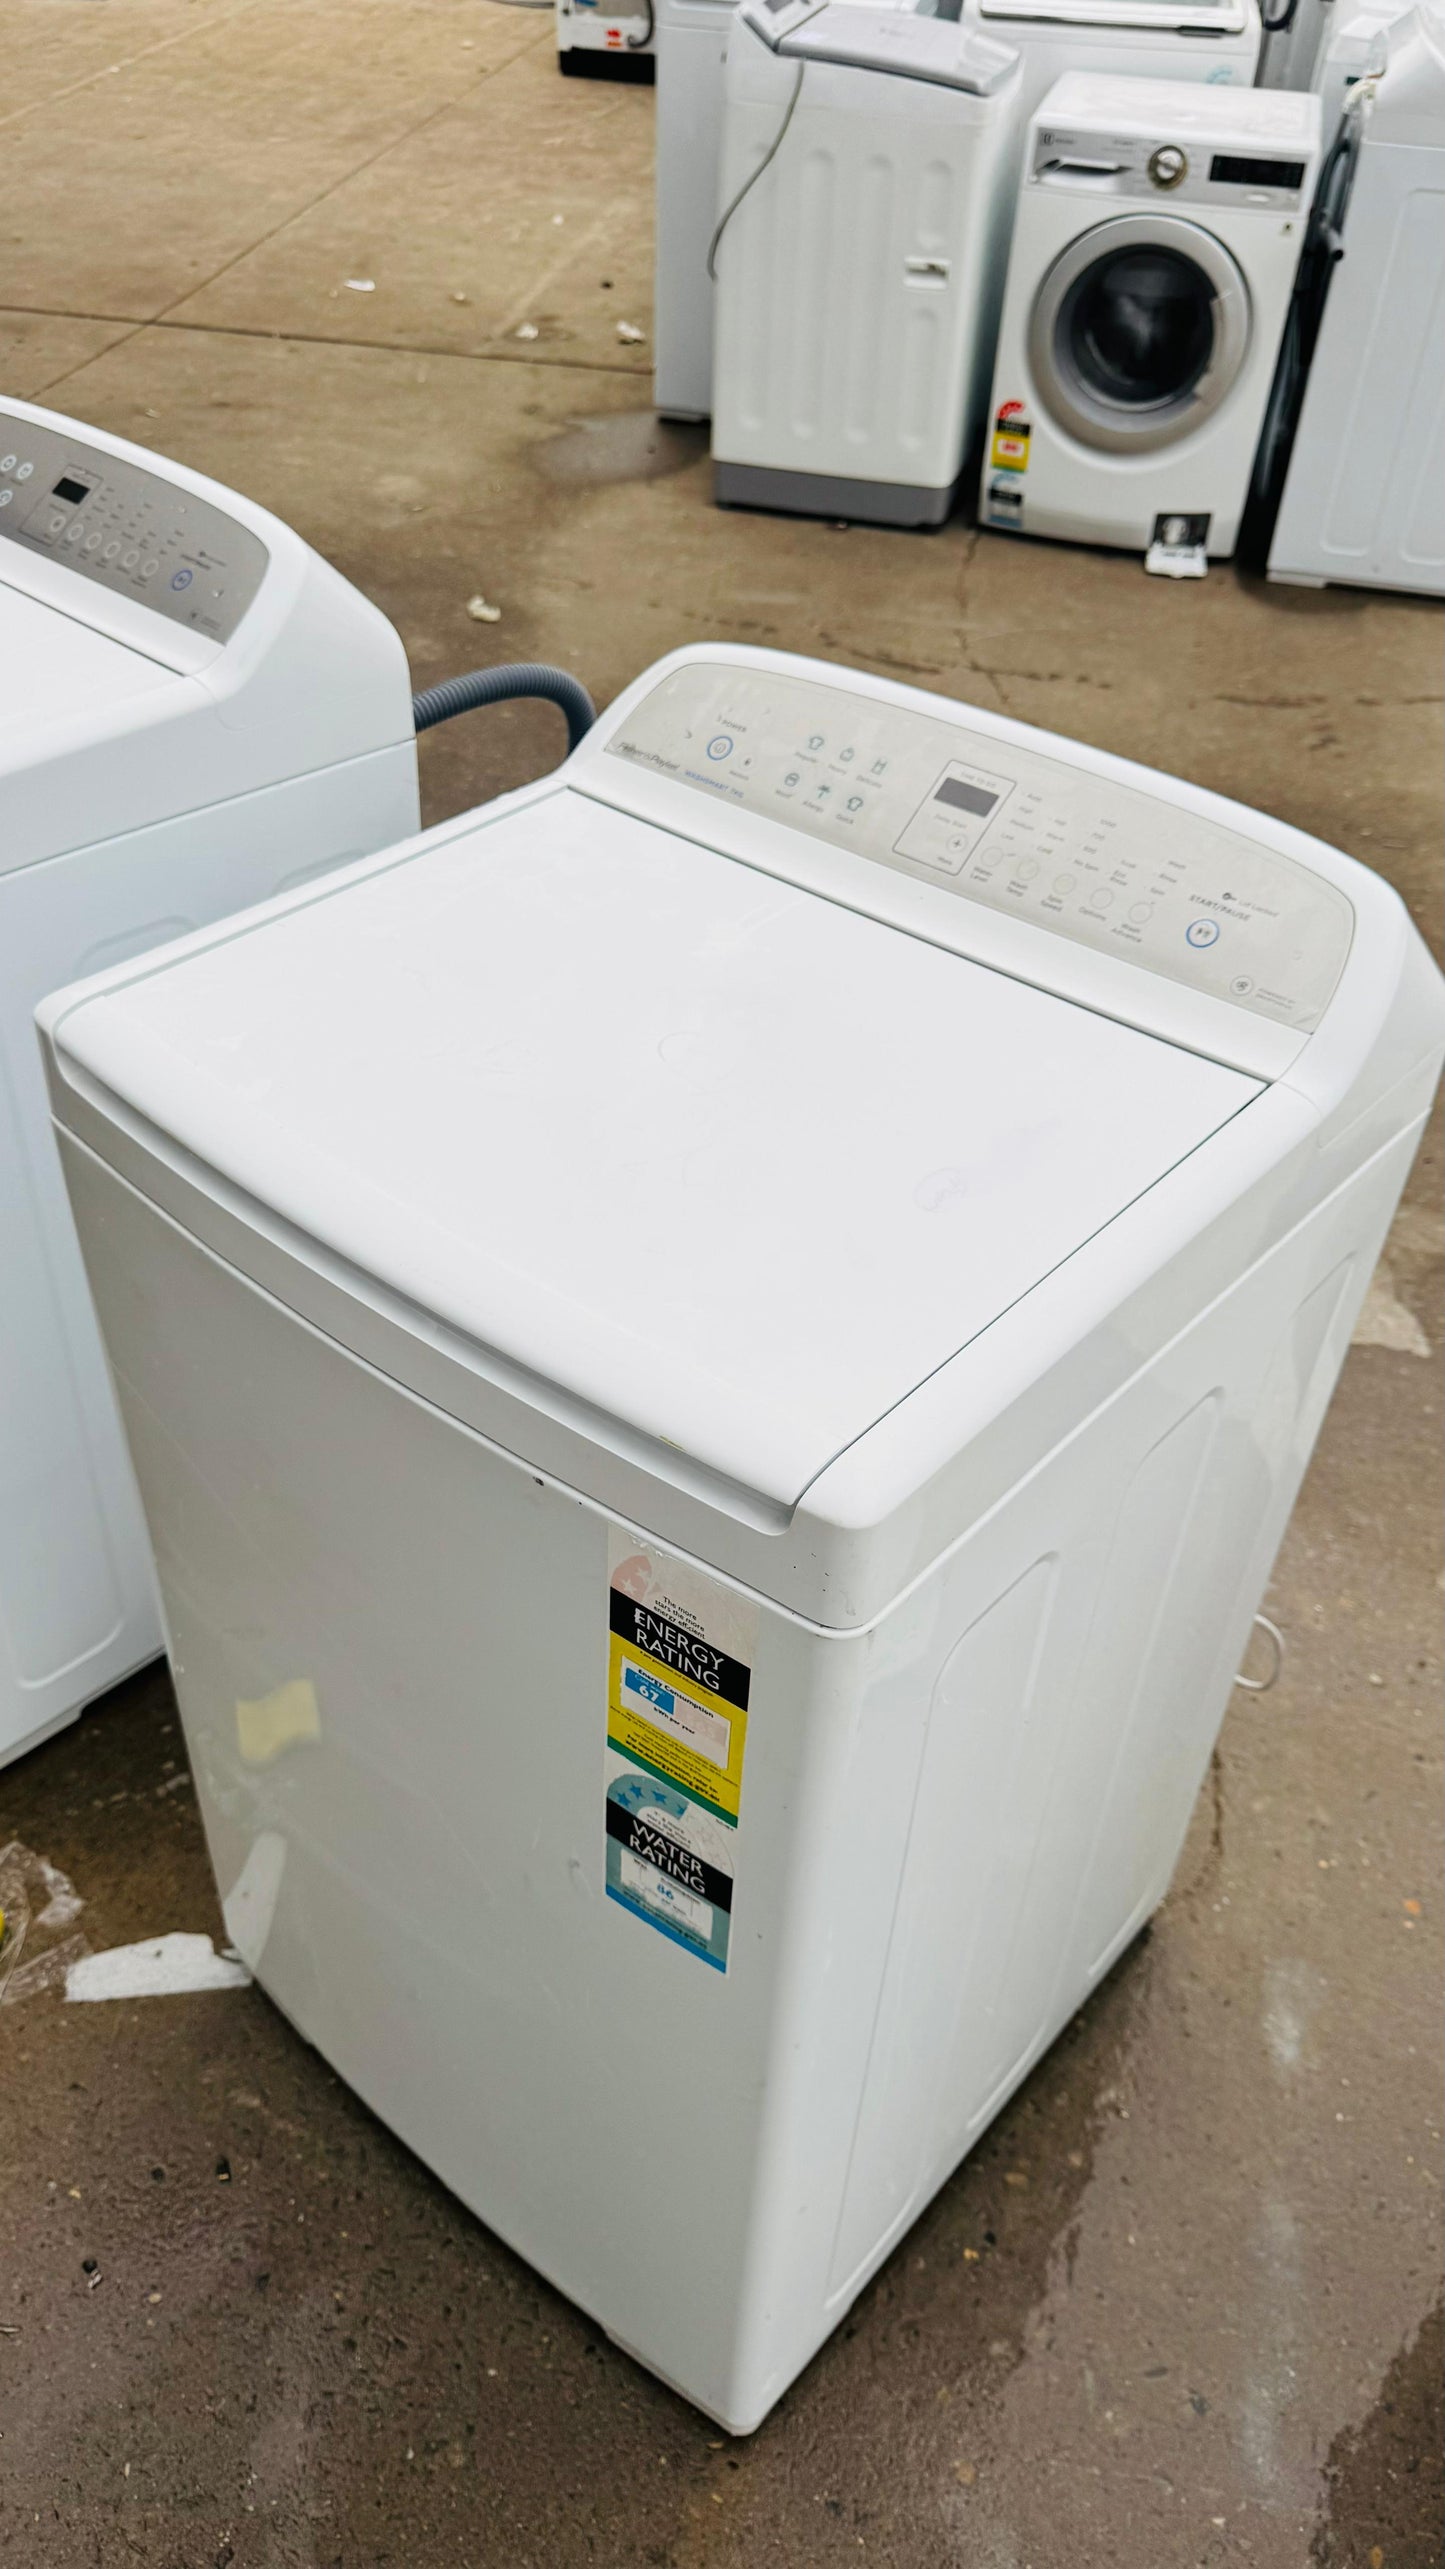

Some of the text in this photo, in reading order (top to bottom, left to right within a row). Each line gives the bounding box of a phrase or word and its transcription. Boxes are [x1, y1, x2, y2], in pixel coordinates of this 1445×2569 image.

[1188, 893, 1252, 922] START/PAUSE
[653, 1606, 677, 1623] energy
[654, 1599, 705, 1632] stars the more
[663, 1595, 697, 1621] The more
[633, 1607, 725, 1671] ENERGY
[636, 1627, 720, 1691] RATING
[638, 1668, 715, 1719] Energy Consumption
[638, 1684, 660, 1703] 67
[653, 1706, 696, 1736] kWh per year
[629, 1834, 706, 1894] RATING
[632, 1819, 704, 1877] WATER
